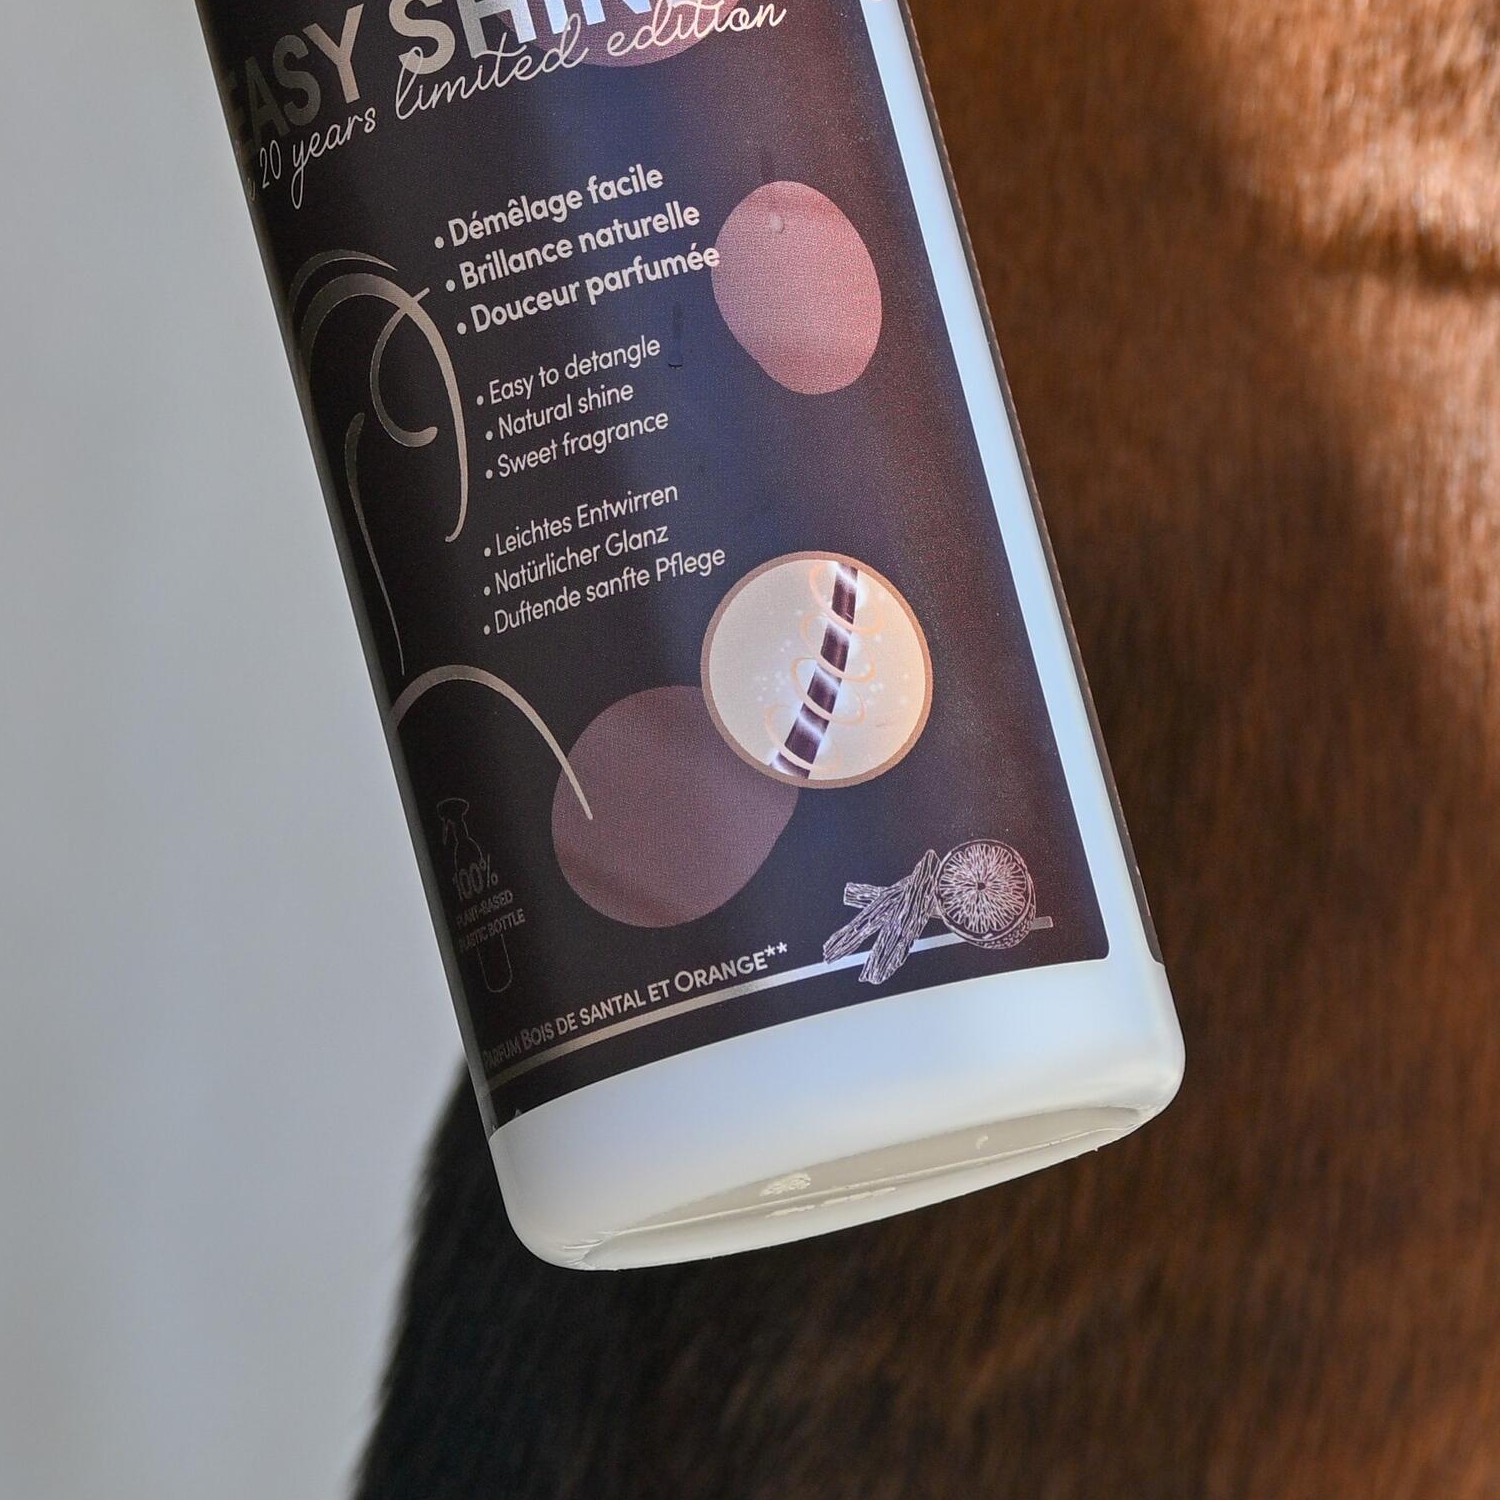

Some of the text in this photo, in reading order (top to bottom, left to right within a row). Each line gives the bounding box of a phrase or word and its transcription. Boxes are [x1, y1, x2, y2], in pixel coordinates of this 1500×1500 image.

[259, 139, 282, 190] 20
[290, 106, 378, 210] years
[395, 14, 589, 120] limited
[447, 163, 664, 248] Démêlage facile
[458, 199, 701, 292] Brillance naturelle
[470, 242, 721, 335] Douceur parfumée
[488, 335, 661, 405] Easy to detangle
[497, 411, 670, 478] Sweet fragrance
[498, 381, 634, 440] Natural shine
[495, 484, 678, 557] Leichtes Entwirren
[494, 524, 669, 597] Natürlicher Glanz
[494, 546, 726, 633] Duftende sanfte Pflege
[488, 908, 526, 937] BOTTLE
[555, 1012, 579, 1036] DE
[579, 992, 647, 1027] SANTAL
[647, 979, 670, 1003] ET
